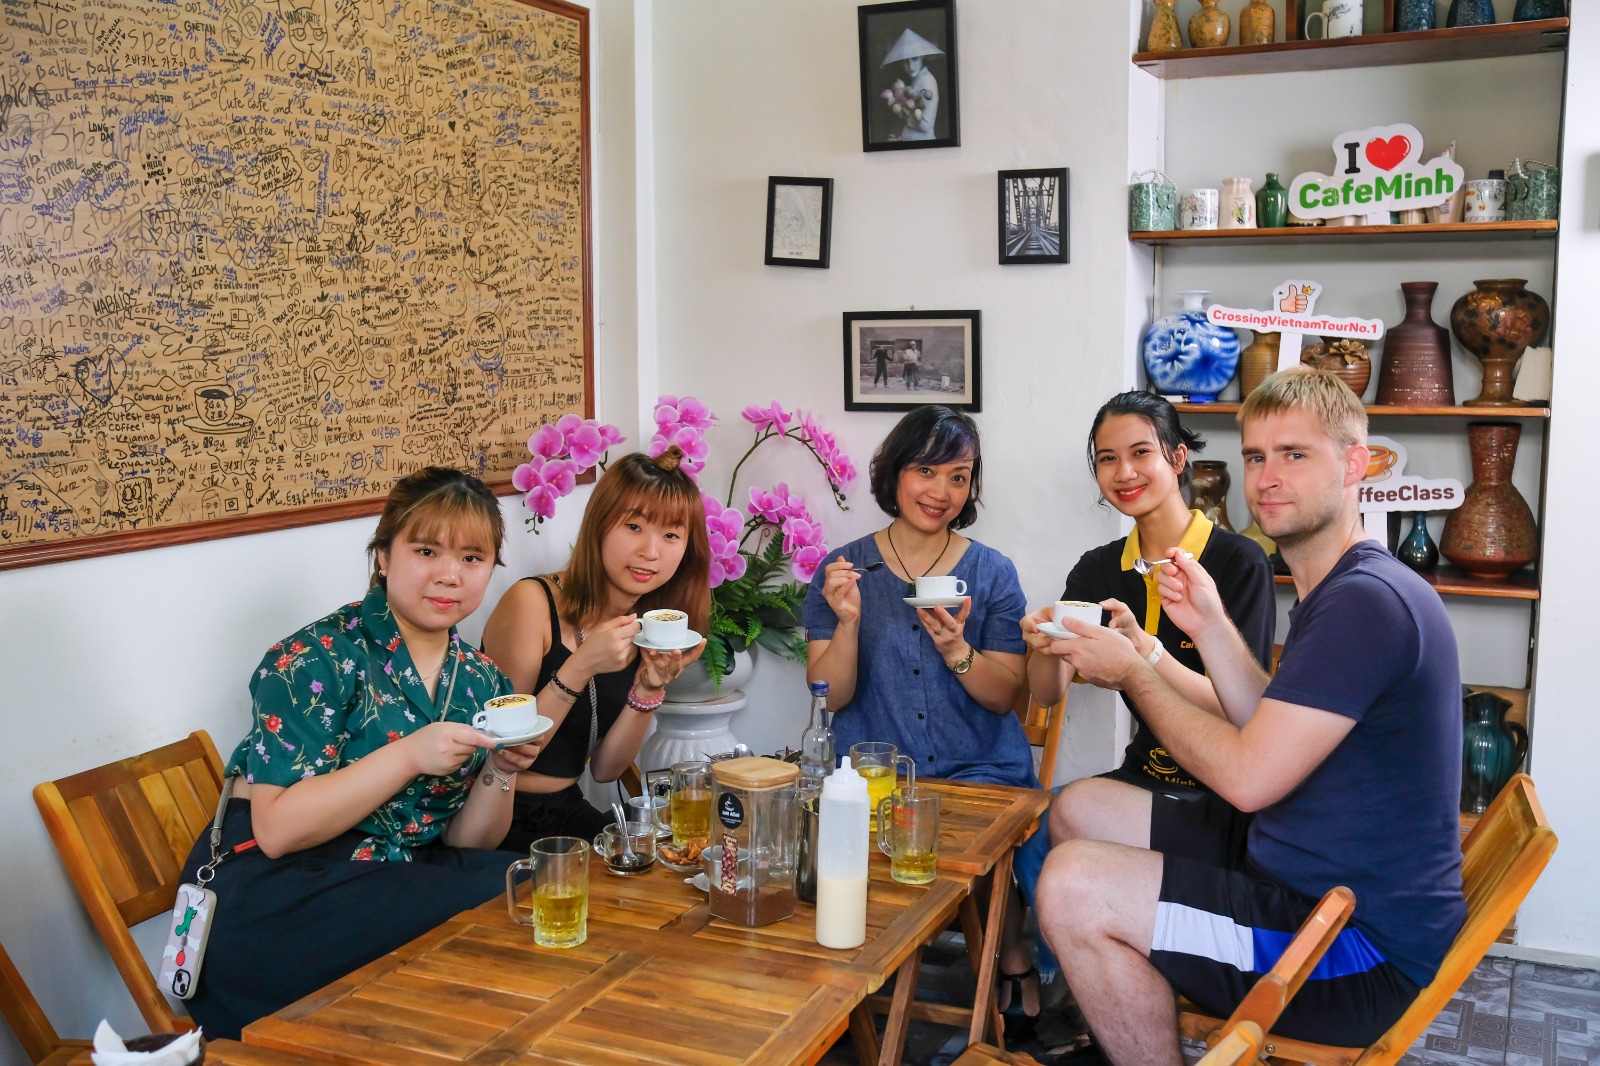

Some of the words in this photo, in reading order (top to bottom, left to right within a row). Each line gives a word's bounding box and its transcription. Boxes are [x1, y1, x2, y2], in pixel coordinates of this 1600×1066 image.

[1343, 142, 1361, 174] I
[1299, 168, 1454, 209] CafeMinh
[306, 245, 322, 253] LOVE
[1213, 310, 1378, 333] CrossingVietnamTourNo.1
